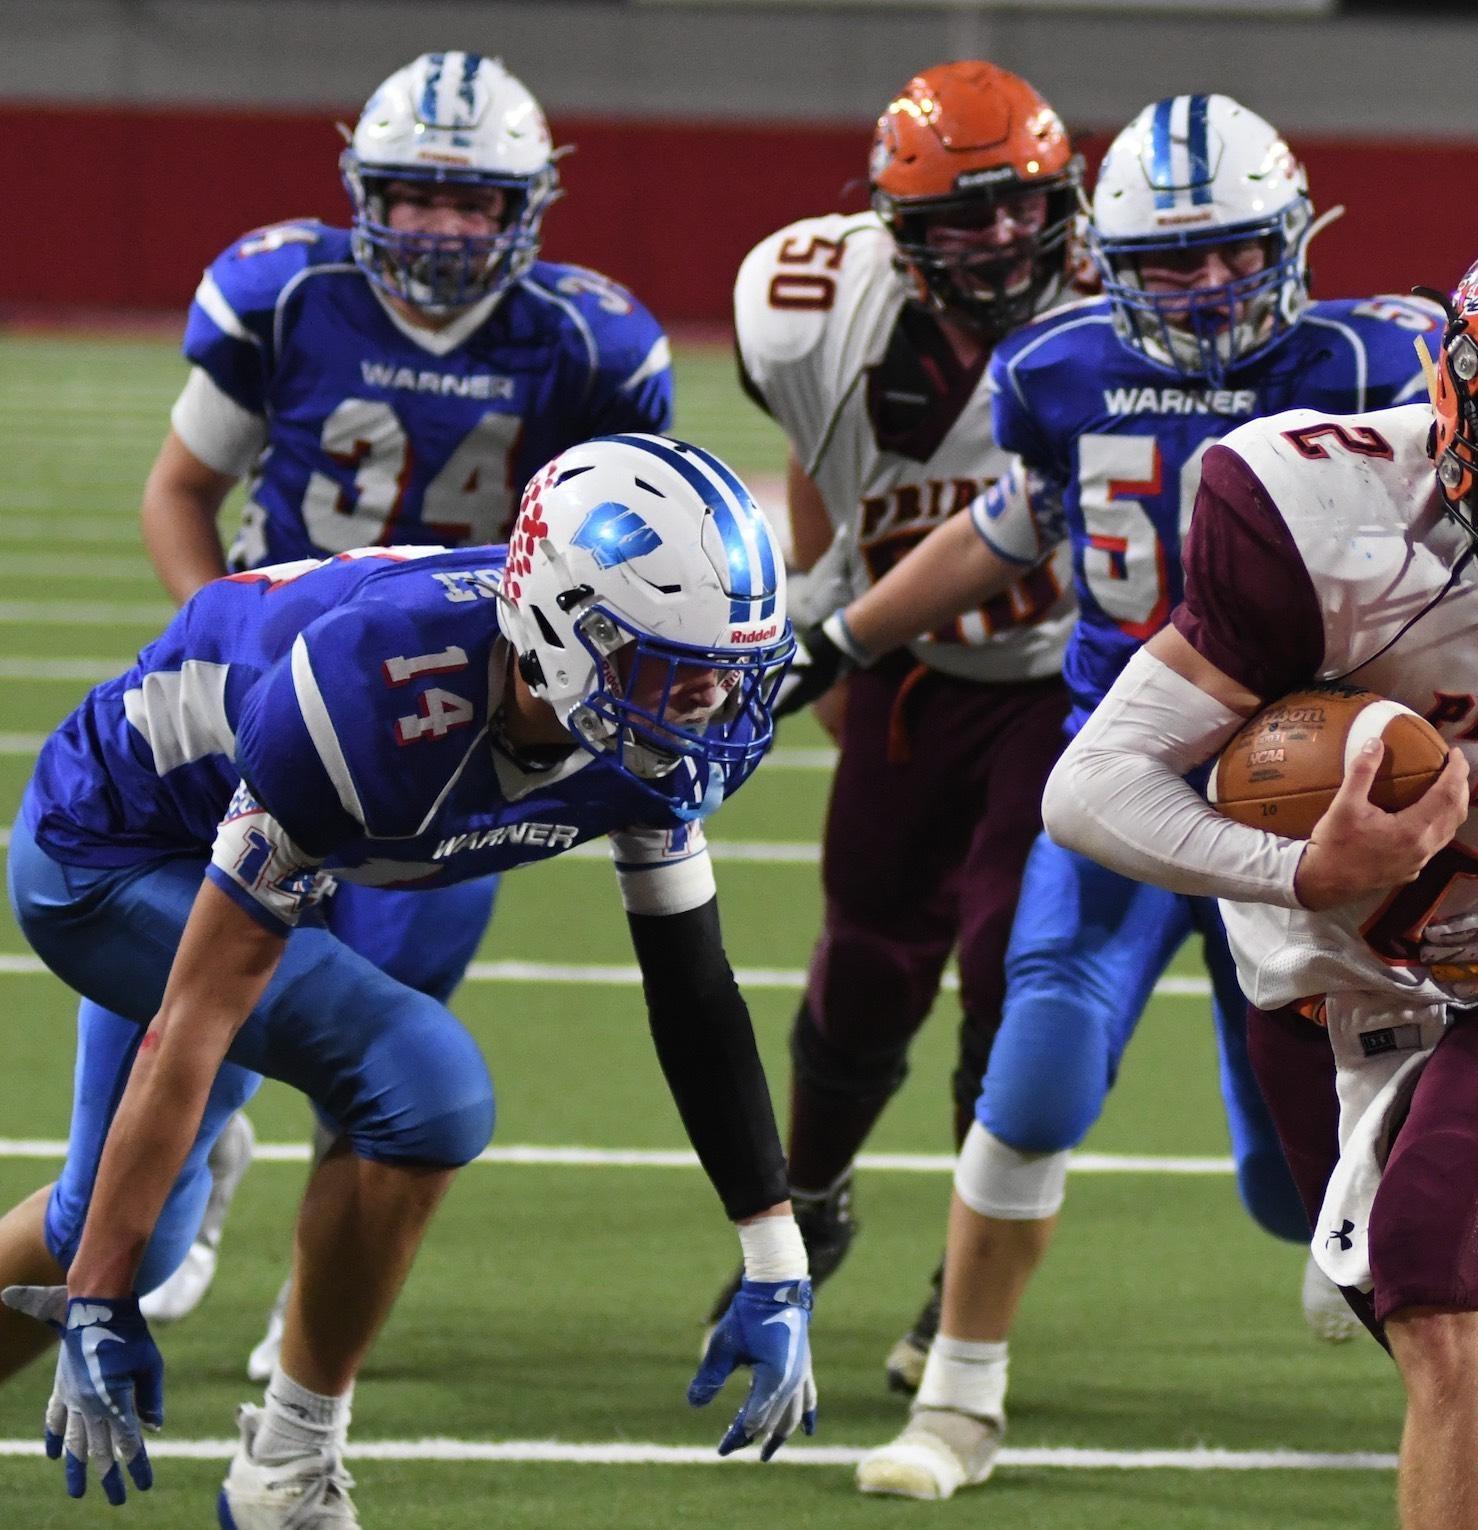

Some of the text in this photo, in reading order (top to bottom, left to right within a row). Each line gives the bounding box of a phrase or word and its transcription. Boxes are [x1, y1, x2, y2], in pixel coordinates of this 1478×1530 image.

[768, 235, 847, 312] 50
[360, 360, 515, 400] WARNER
[1103, 389, 1258, 416] WARNER
[1281, 423, 1393, 462] 2
[301, 397, 524, 554] 34
[730, 624, 776, 644] Riddell
[381, 645, 475, 747] 14
[432, 821, 580, 861] WARNER
